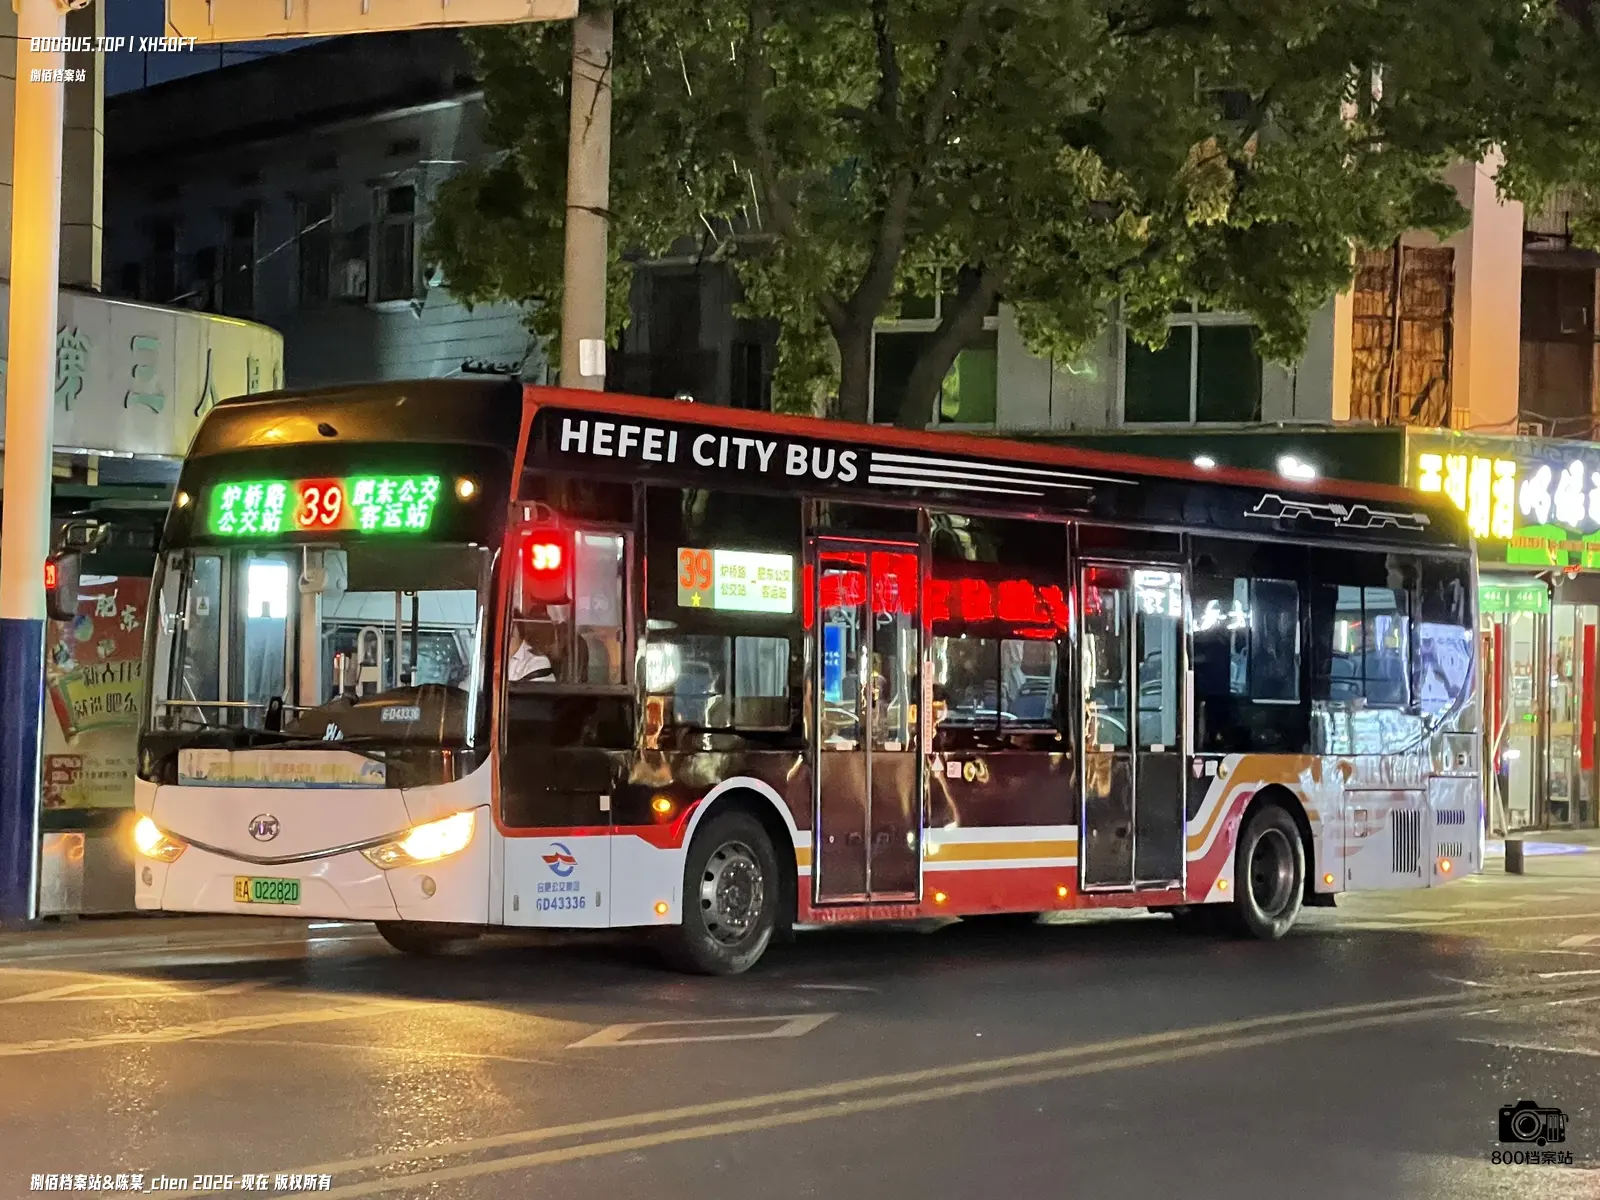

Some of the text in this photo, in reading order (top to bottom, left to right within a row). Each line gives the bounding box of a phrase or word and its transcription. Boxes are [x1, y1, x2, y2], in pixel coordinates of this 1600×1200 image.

[560, 418, 858, 482] HEFEI CITY BUS
[300, 486, 343, 526] 39
[680, 549, 713, 591] 39
[255, 881, 299, 901] 02282D
